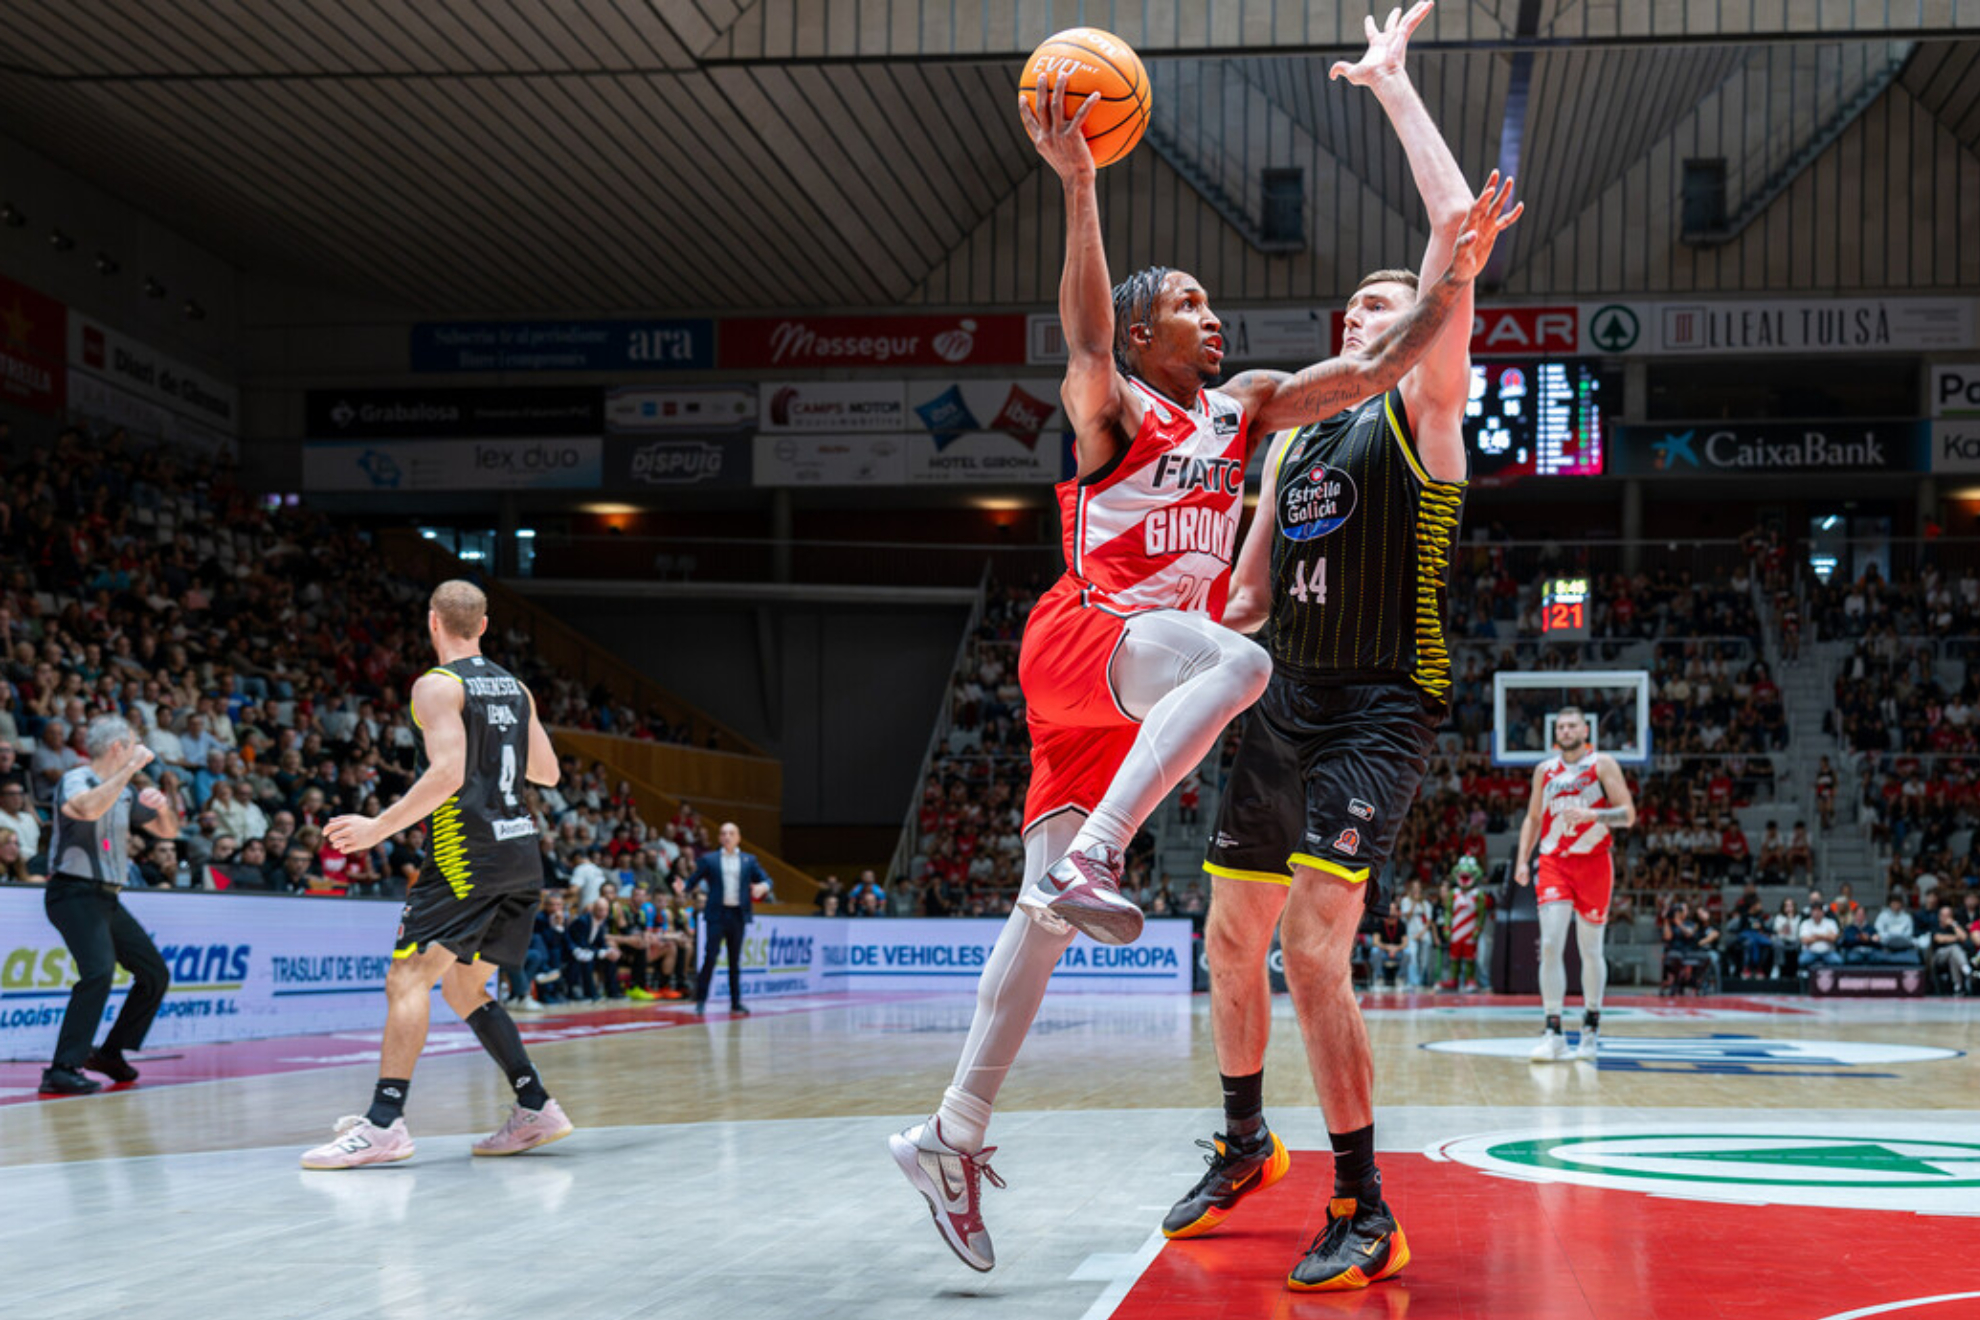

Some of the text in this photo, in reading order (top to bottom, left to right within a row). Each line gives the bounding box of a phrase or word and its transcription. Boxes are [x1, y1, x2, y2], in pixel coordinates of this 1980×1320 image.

[1032, 55, 1081, 75] EVO
[1472, 313, 1577, 345] PAR
[1709, 307, 1788, 347] LLEAL
[1804, 302, 1891, 344] TULSÀ
[627, 327, 694, 361] ara
[768, 321, 920, 365] Massegur
[359, 401, 461, 423] Grabalosa
[793, 401, 901, 414] CAMPS MOTOR
[1004, 399, 1041, 430] ibis
[475, 444, 579, 468] lex duo
[631, 450, 723, 474] DISPUIG
[929, 456, 1039, 468] HOTEL GIRONA
[1704, 430, 1886, 469] CaixaBank
[1286, 480, 1341, 506] Estrella
[1287, 499, 1337, 524] Galicia
[1289, 557, 1327, 605] 44
[1551, 603, 1583, 628] 21
[499, 745, 518, 806] 4
[851, 945, 879, 966] DE
[883, 945, 985, 967] VEHICLES
[1093, 947, 1178, 967] EUROPA
[272, 956, 333, 983] TRASLLAT
[337, 957, 352, 981] DE
[1, 1001, 66, 1028] LOGÍST
